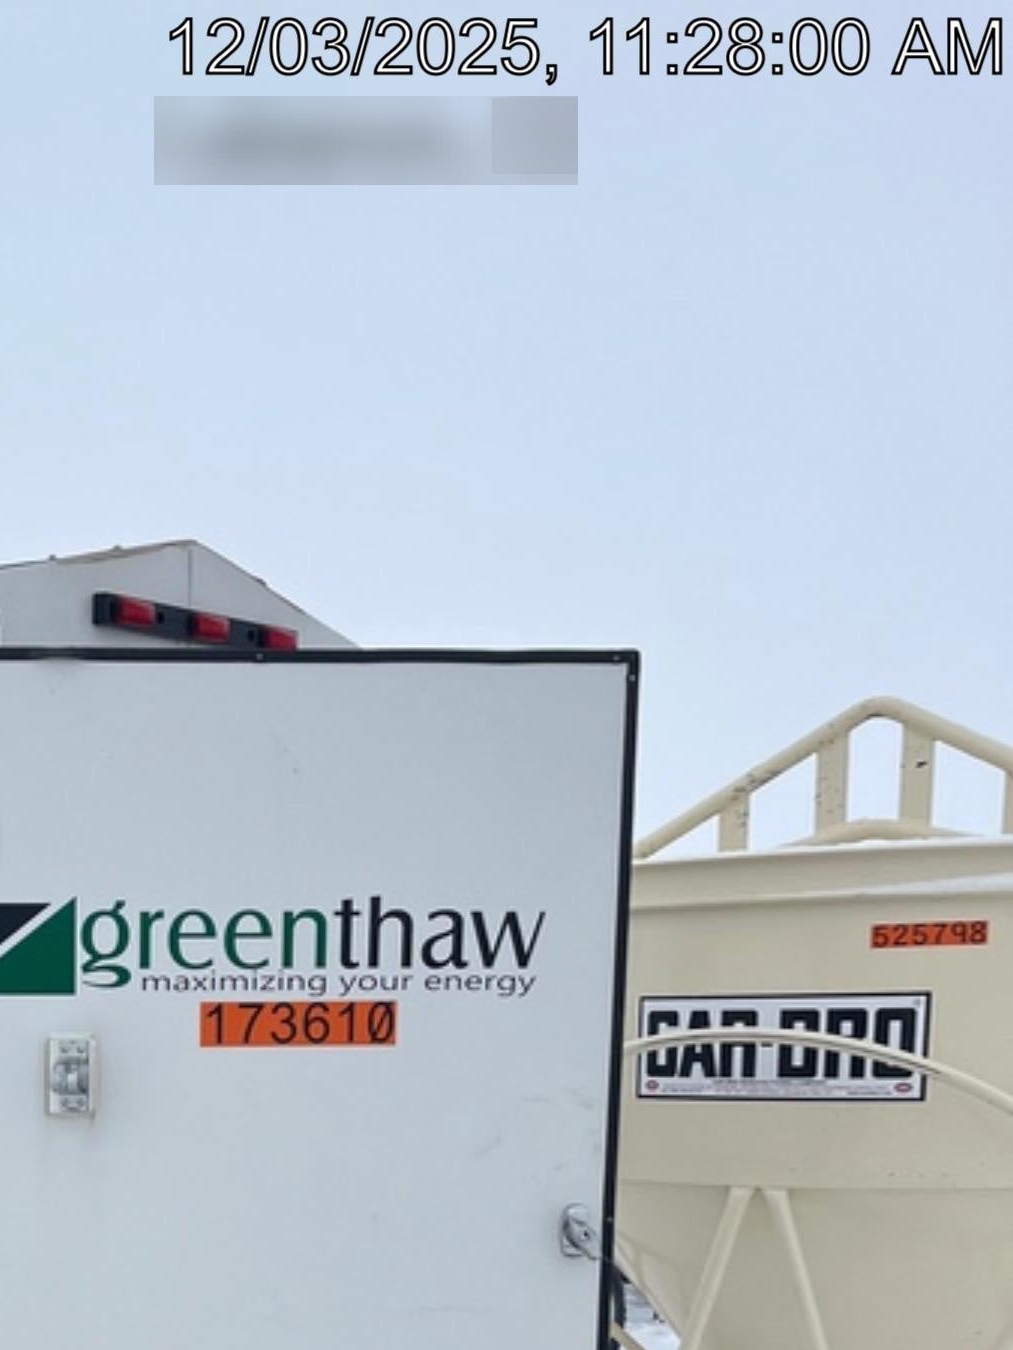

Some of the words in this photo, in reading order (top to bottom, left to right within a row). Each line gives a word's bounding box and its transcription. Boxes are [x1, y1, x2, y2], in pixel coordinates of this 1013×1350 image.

[80, 896, 547, 988] greenthaw
[871, 921, 987, 948] 525798
[141, 969, 328, 997] maximizing
[339, 974, 415, 997] your
[424, 974, 537, 997] energy
[205, 1001, 396, 1045] 173610
